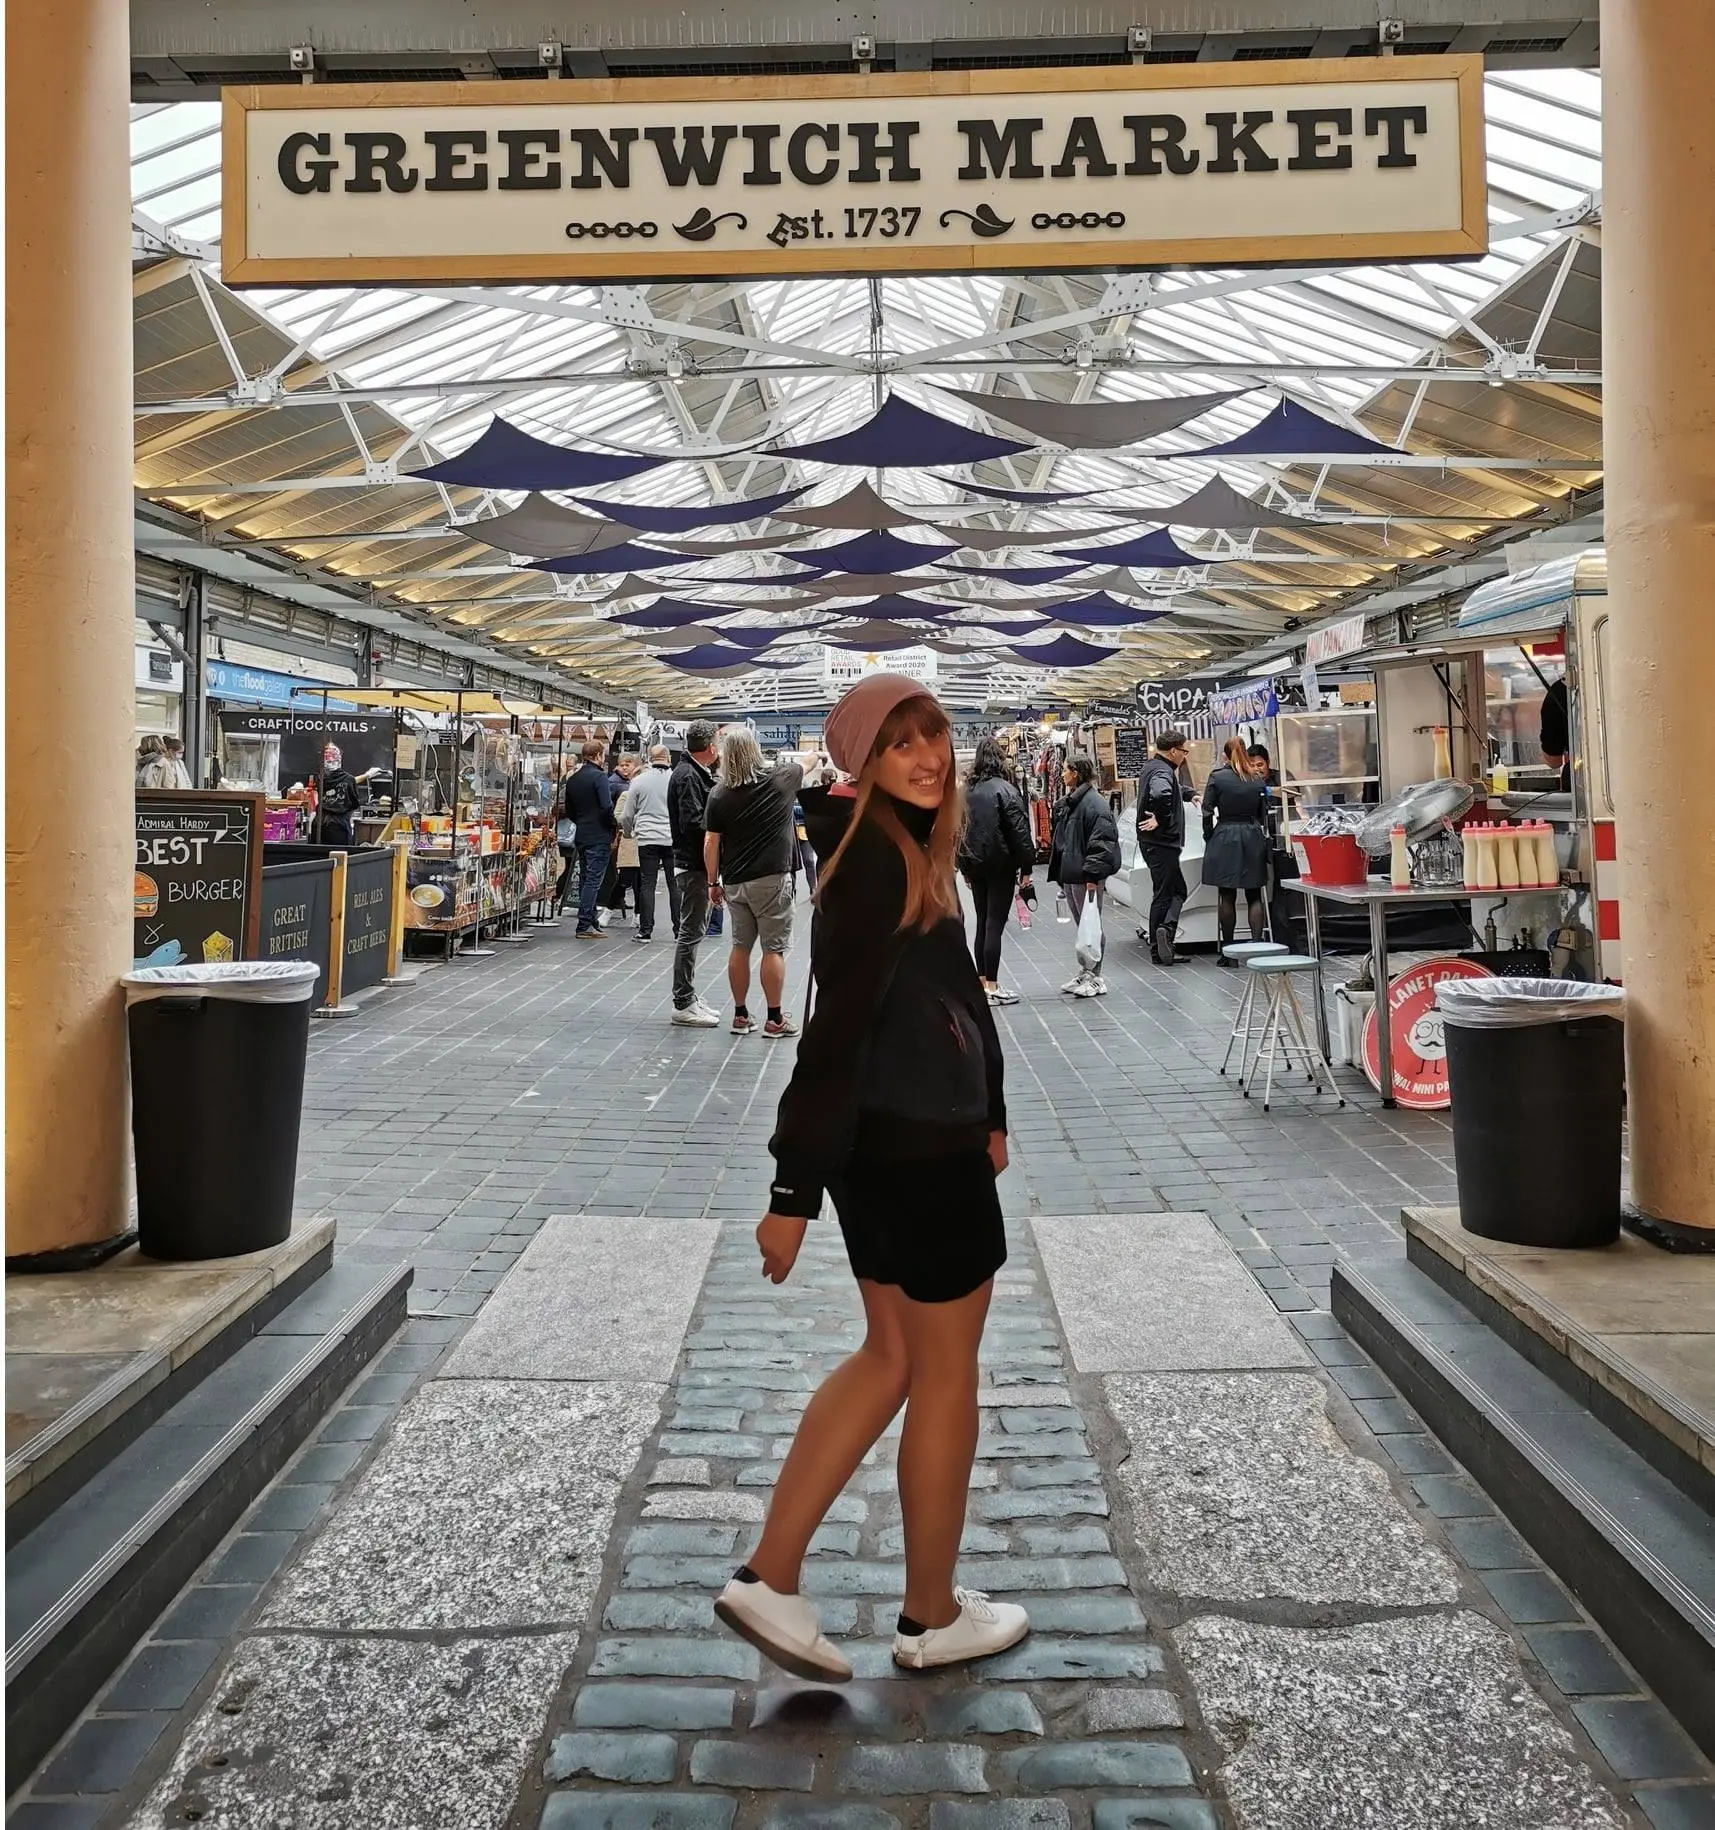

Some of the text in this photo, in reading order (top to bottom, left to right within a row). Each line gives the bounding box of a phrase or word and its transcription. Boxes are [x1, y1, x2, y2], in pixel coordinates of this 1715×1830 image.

[277, 105, 1428, 195] GREENWICH MARKET
[766, 206, 922, 249] Est. 1737
[248, 718, 369, 733] CRAFT COCKTAILS
[137, 815, 211, 829] ADMIRAL HARDY
[135, 836, 209, 865] BEST
[168, 878, 243, 903] BURGER
[353, 888, 384, 909] REAL ALES
[273, 904, 306, 927] GREAT
[365, 913, 372, 927] &
[269, 930, 309, 955] BRITISH
[347, 928, 387, 955] CRAFT BEERS
[1390, 972, 1435, 1017] LANET
[1412, 1082, 1435, 1095] MINI
